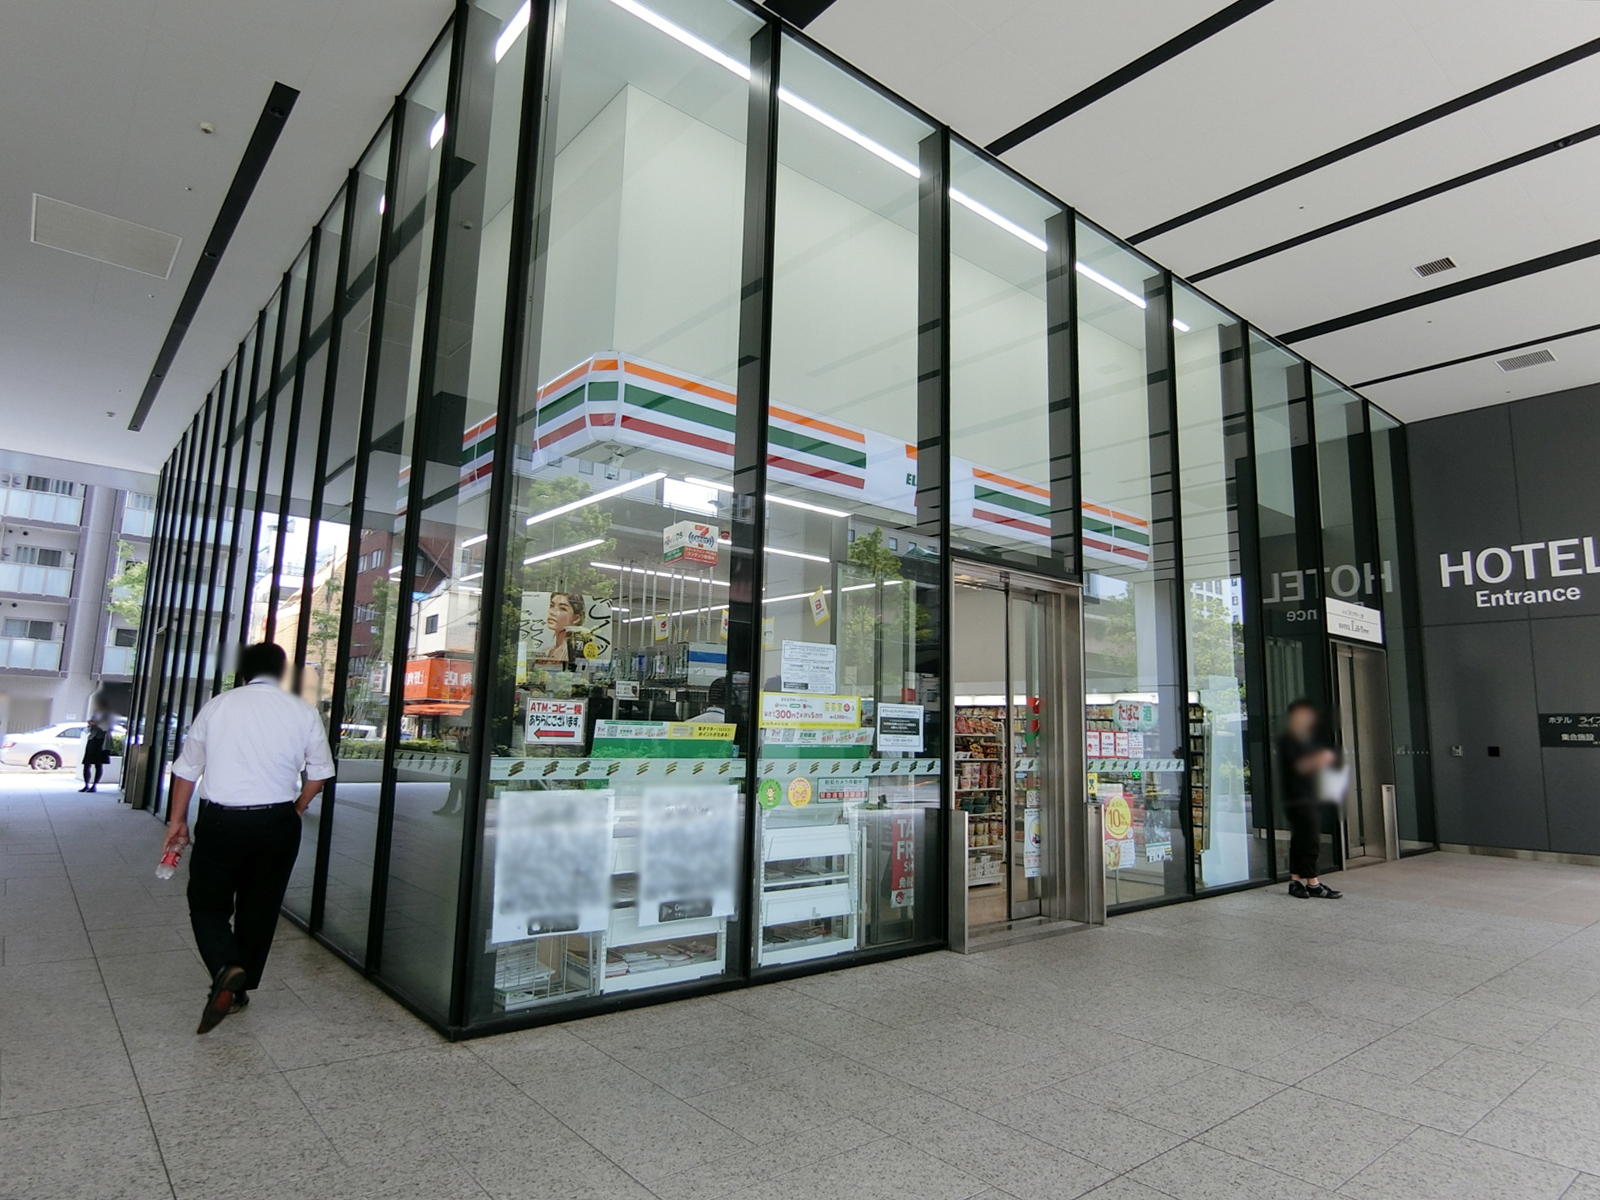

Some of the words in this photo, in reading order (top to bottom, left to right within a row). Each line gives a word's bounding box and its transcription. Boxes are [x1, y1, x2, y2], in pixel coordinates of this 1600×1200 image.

[1439, 536, 1600, 588] HOTEL
[1475, 586, 1582, 608] Entrance
[1118, 703, 1139, 721] たばこ
[1548, 716, 1573, 724] ホテル
[897, 819, 914, 839] TA
[896, 841, 914, 860] FR
[903, 861, 914, 872] SH
